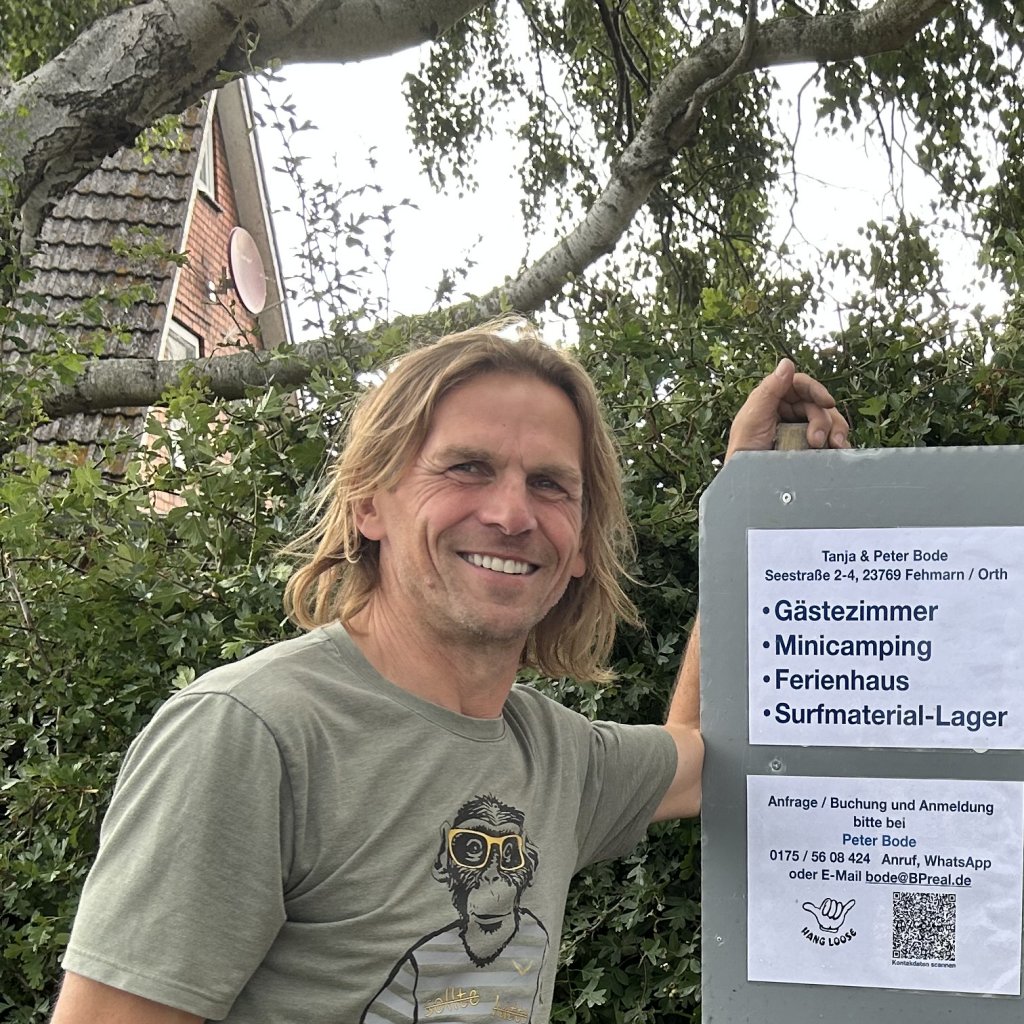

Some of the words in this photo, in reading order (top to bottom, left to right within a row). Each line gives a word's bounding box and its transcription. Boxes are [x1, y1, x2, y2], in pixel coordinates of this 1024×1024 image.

[822, 550, 856, 563] Tanja
[860, 550, 870, 562] &
[874, 550, 909, 562] Peter
[913, 550, 948, 562] Bode
[765, 569, 830, 582] Seestraße
[834, 569, 859, 583] 2-4,
[862, 569, 901, 581] 23769
[905, 568, 965, 581] Fehmarn
[968, 568, 974, 581] /
[978, 568, 1008, 581] Orth
[774, 600, 938, 622] Gästezimmer
[775, 634, 932, 661] Minicamping
[775, 669, 910, 691] Ferienhaus
[775, 703, 1008, 732] Surfmaterial-Lager
[768, 796, 818, 810] Anfrage
[821, 796, 827, 808] /
[830, 797, 887, 812] Buchung
[891, 799, 916, 811] und
[919, 800, 994, 816] Anmeldung
[853, 816, 882, 829] bitte
[886, 817, 906, 829] bei
[842, 834, 878, 847] Peter
[882, 835, 917, 848] Bode
[770, 850, 799, 862] 0175
[802, 850, 807, 862] /
[811, 851, 826, 863] 56
[829, 852, 845, 863] 08
[848, 852, 871, 864] 424
[881, 854, 921, 868] Anruf,
[924, 855, 992, 871] WhatsApp
[789, 869, 818, 881] oder
[821, 869, 862, 882] E-Mail
[865, 871, 972, 887] bode@BPreal.de
[801, 927, 825, 946] HANG
[828, 928, 857, 946] LOOSE
